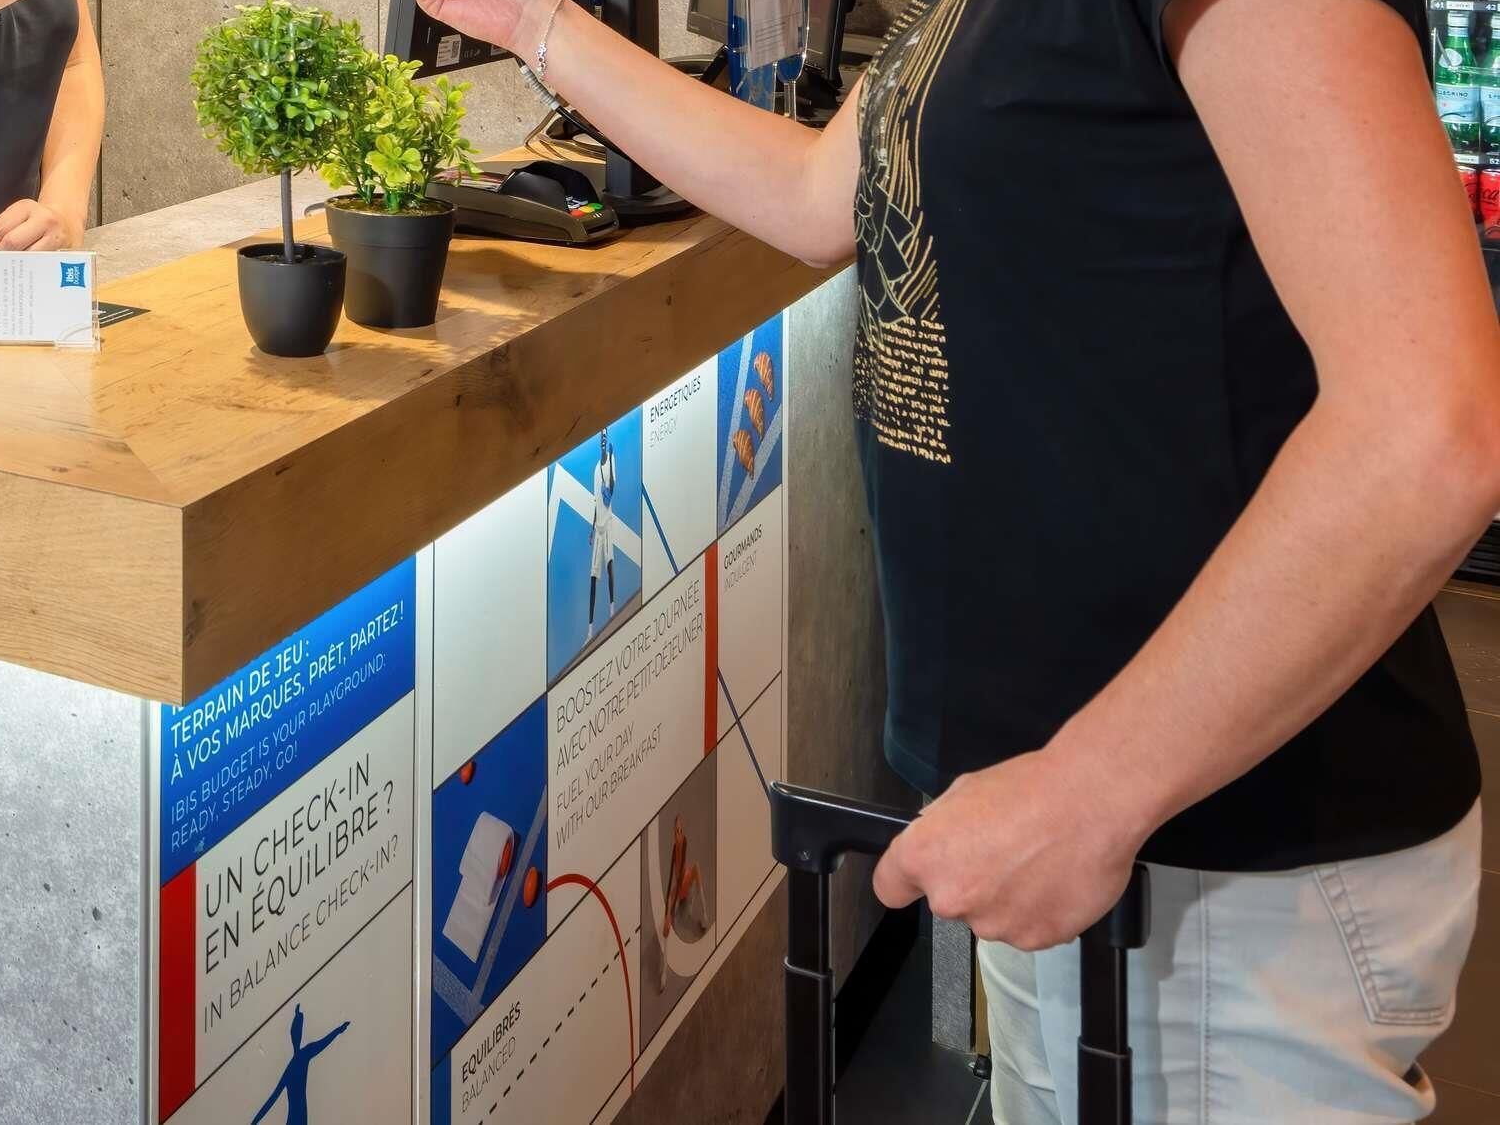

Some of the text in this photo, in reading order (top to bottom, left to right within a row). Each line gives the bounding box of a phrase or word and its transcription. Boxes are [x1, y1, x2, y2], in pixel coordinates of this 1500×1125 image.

[724, 524, 763, 570] GOURMANDS
[170, 680, 243, 748] TERRAIN
[249, 662, 271, 696] DE
[170, 753, 183, 786] À
[188, 736, 221, 770] VOS
[227, 677, 306, 746] MARQUES,
[309, 643, 347, 686] PRÊT,
[557, 579, 700, 733] BOOSTEZ VOTRE JOURNÉE
[557, 612, 703, 775] AVEC NOTRE PETIT-DÉJEUNER
[171, 651, 387, 825] IBIS BUDGET IS YOUR PLAYGROUND:
[171, 739, 298, 853] READY, STEADY, GO!
[556, 722, 663, 851] WITH OUR BREAKFAST
[557, 721, 635, 815] FUEL YOUR DAY
[206, 754, 370, 918] UN CHECK-IN
[204, 834, 399, 1034] IN BALANCE CHECK-IN?
[206, 911, 240, 975] EN
[461, 1035, 516, 1115] BALANCED
